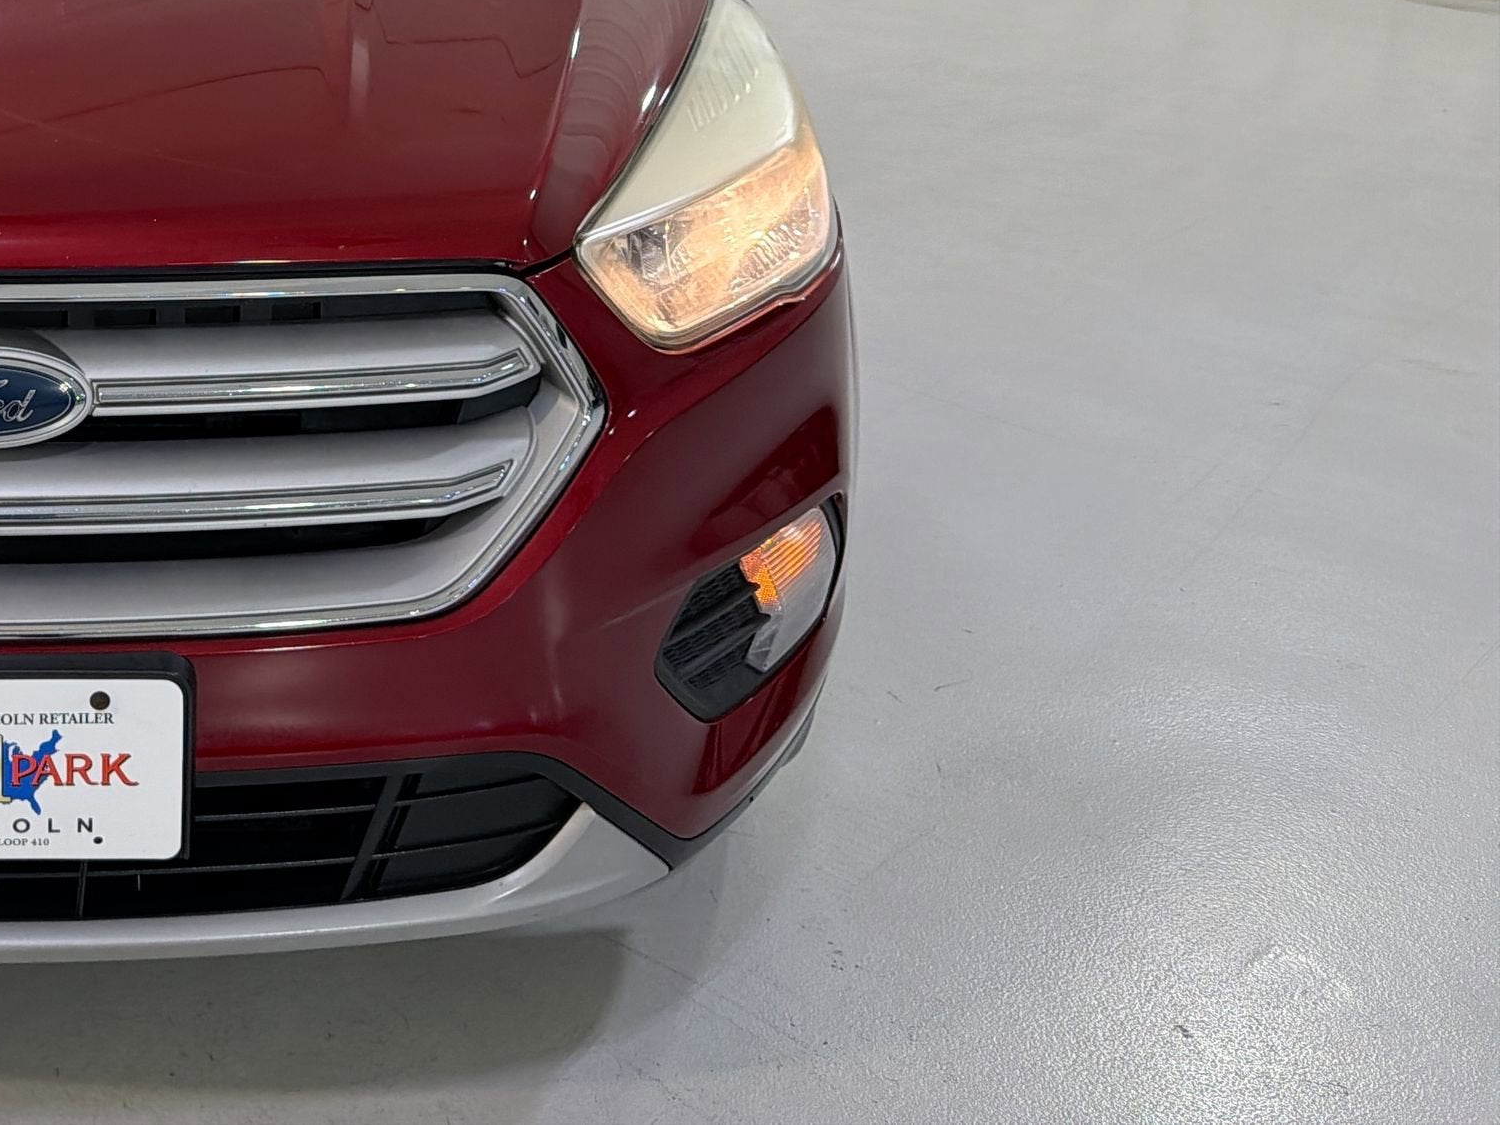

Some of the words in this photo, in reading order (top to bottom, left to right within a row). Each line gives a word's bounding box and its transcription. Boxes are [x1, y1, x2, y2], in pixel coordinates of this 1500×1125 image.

[39, 712, 114, 725] RETAILER
[11, 753, 139, 787] PARK
[31, 838, 49, 846] 410
